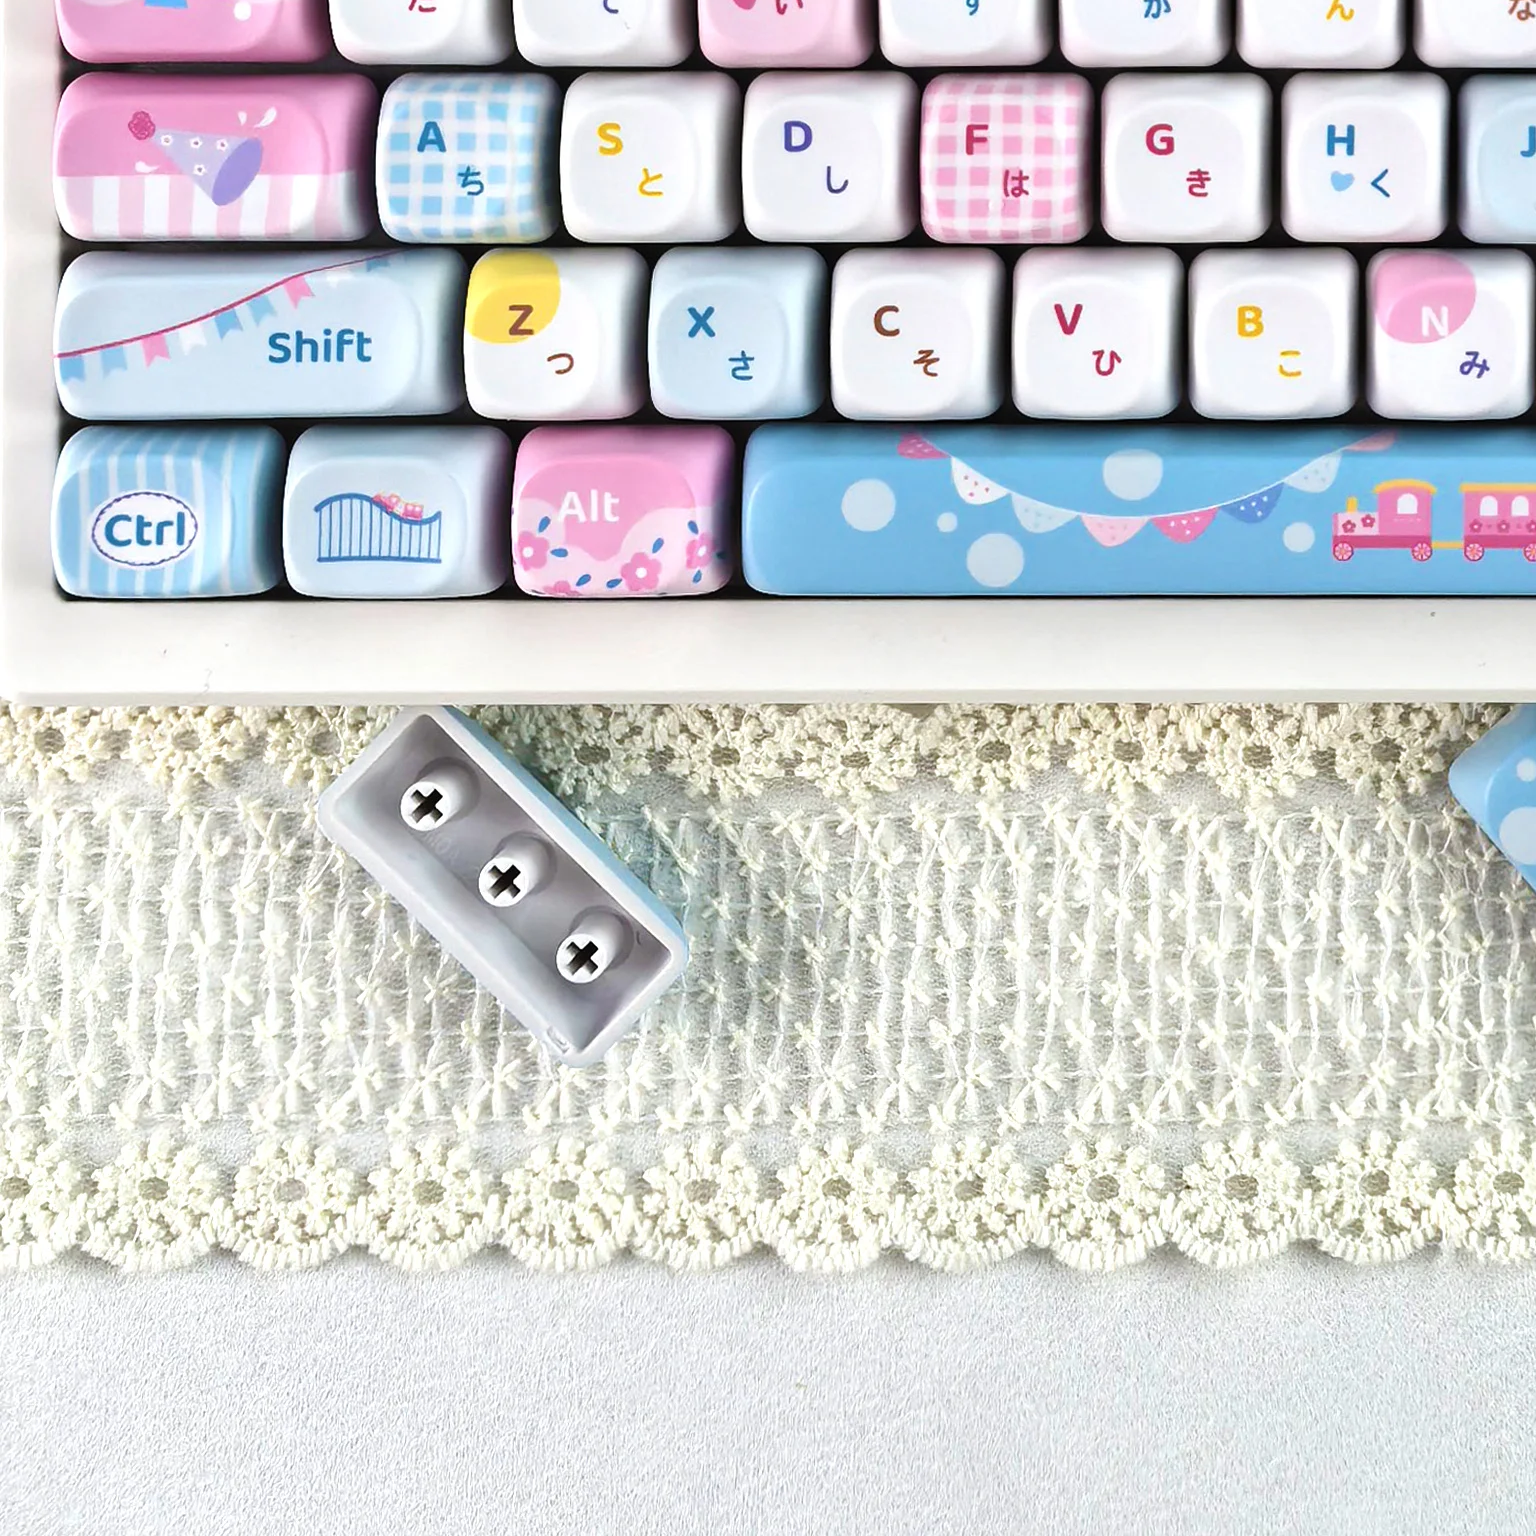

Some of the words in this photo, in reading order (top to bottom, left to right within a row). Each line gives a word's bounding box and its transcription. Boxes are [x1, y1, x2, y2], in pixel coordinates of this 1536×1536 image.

[415, 119, 448, 154] A
[596, 122, 625, 157] S
[783, 119, 813, 153] D
[964, 123, 990, 157] F
[1144, 122, 1176, 157] G
[1326, 123, 1356, 157] H
[457, 164, 486, 197] ち
[637, 167, 665, 197] と
[825, 164, 850, 195] し
[1002, 168, 1031, 199] は
[1185, 167, 1213, 199] き
[1370, 168, 1391, 199] く
[508, 304, 535, 337] Z
[686, 305, 717, 339] X
[872, 304, 902, 339] C
[1053, 302, 1085, 337] V
[1236, 305, 1266, 339] B
[1420, 305, 1451, 338] N
[267, 327, 373, 365] Shift
[546, 352, 575, 376] つ
[727, 351, 755, 382] さ
[912, 348, 941, 379] そ
[1092, 348, 1123, 379] ひ
[1278, 348, 1304, 379] こ
[1458, 349, 1492, 381] み
[557, 489, 621, 524] Alt
[102, 510, 187, 549] Ctrl
